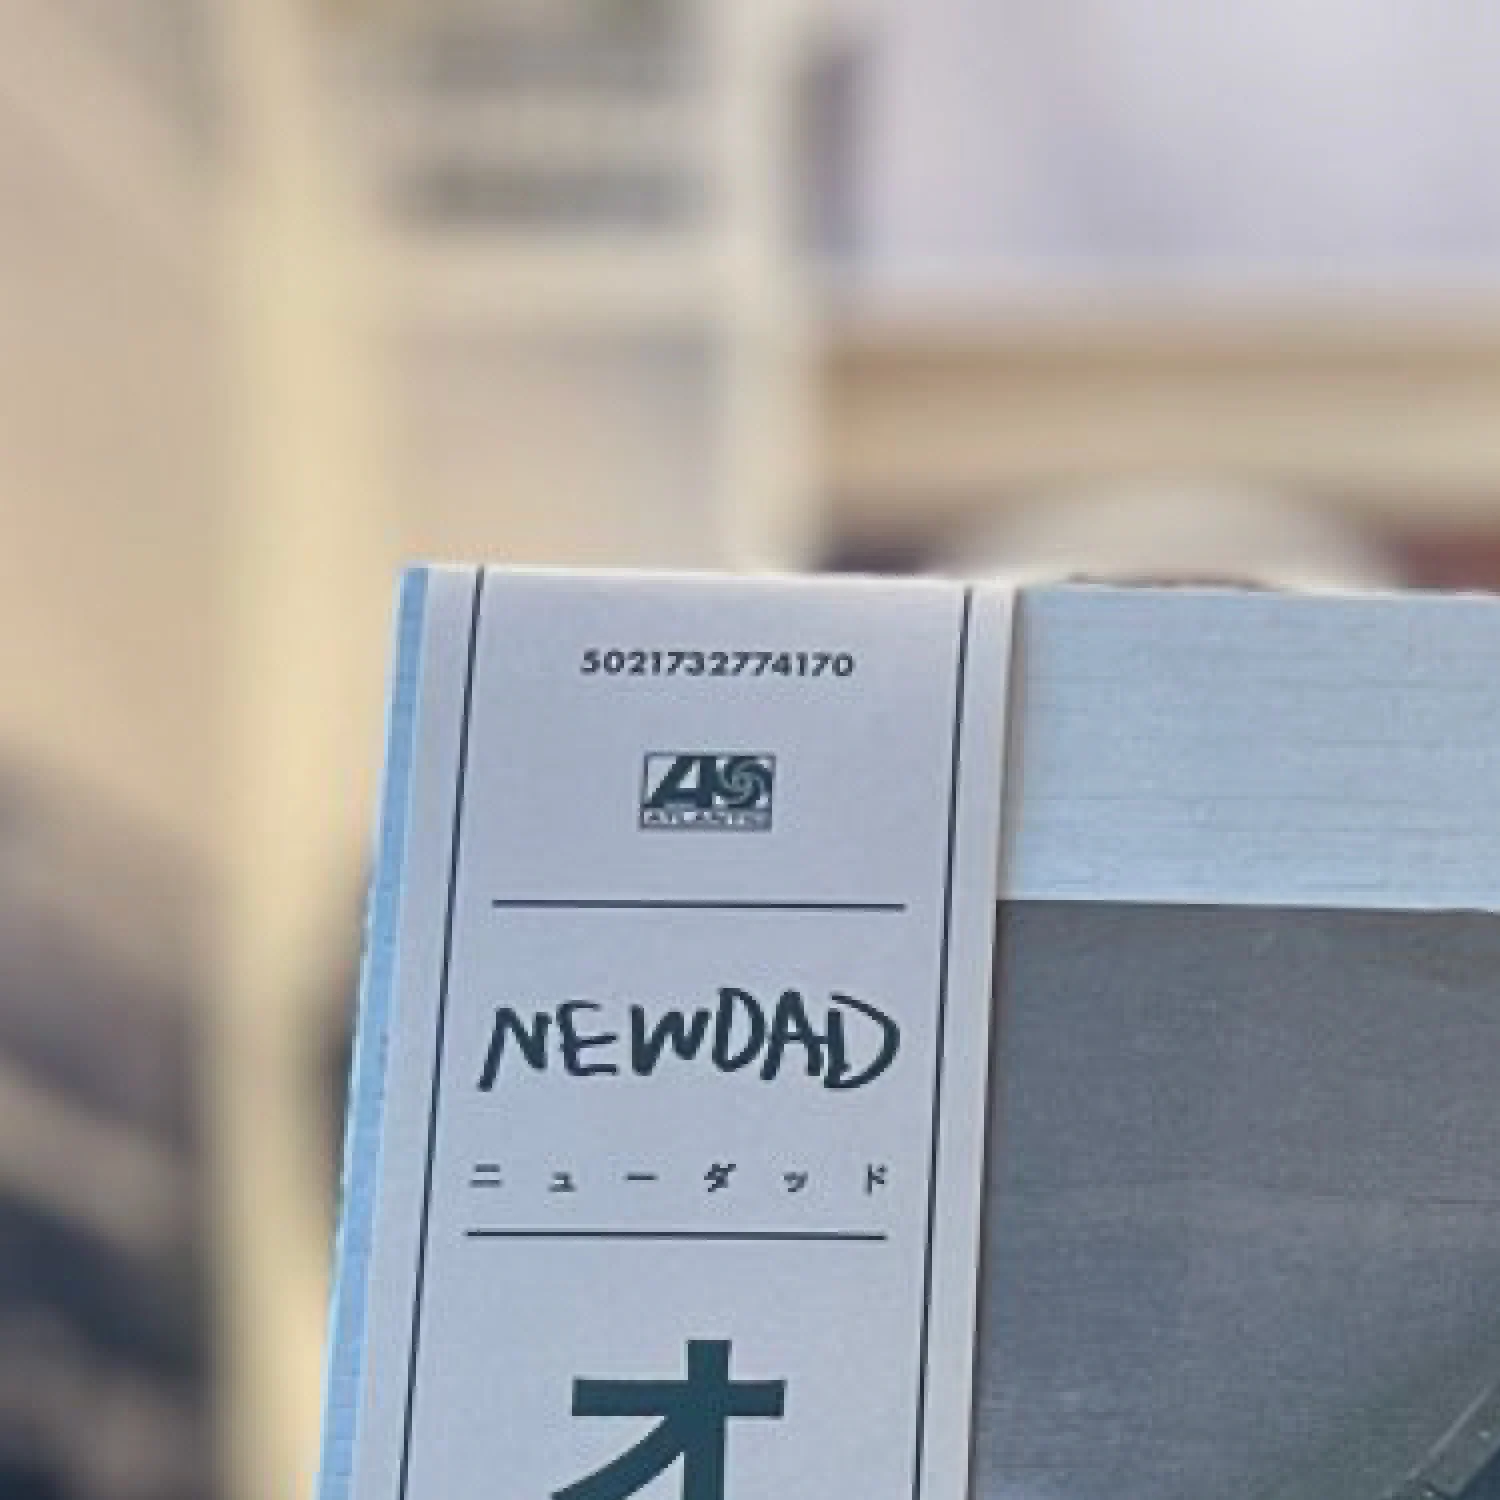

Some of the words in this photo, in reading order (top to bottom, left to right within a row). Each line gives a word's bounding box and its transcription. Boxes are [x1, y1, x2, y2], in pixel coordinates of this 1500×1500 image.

[579, 648, 855, 678] 5021732774170
[476, 986, 901, 1092] NEWDAD
[468, 1160, 890, 1197] ニューダッド
